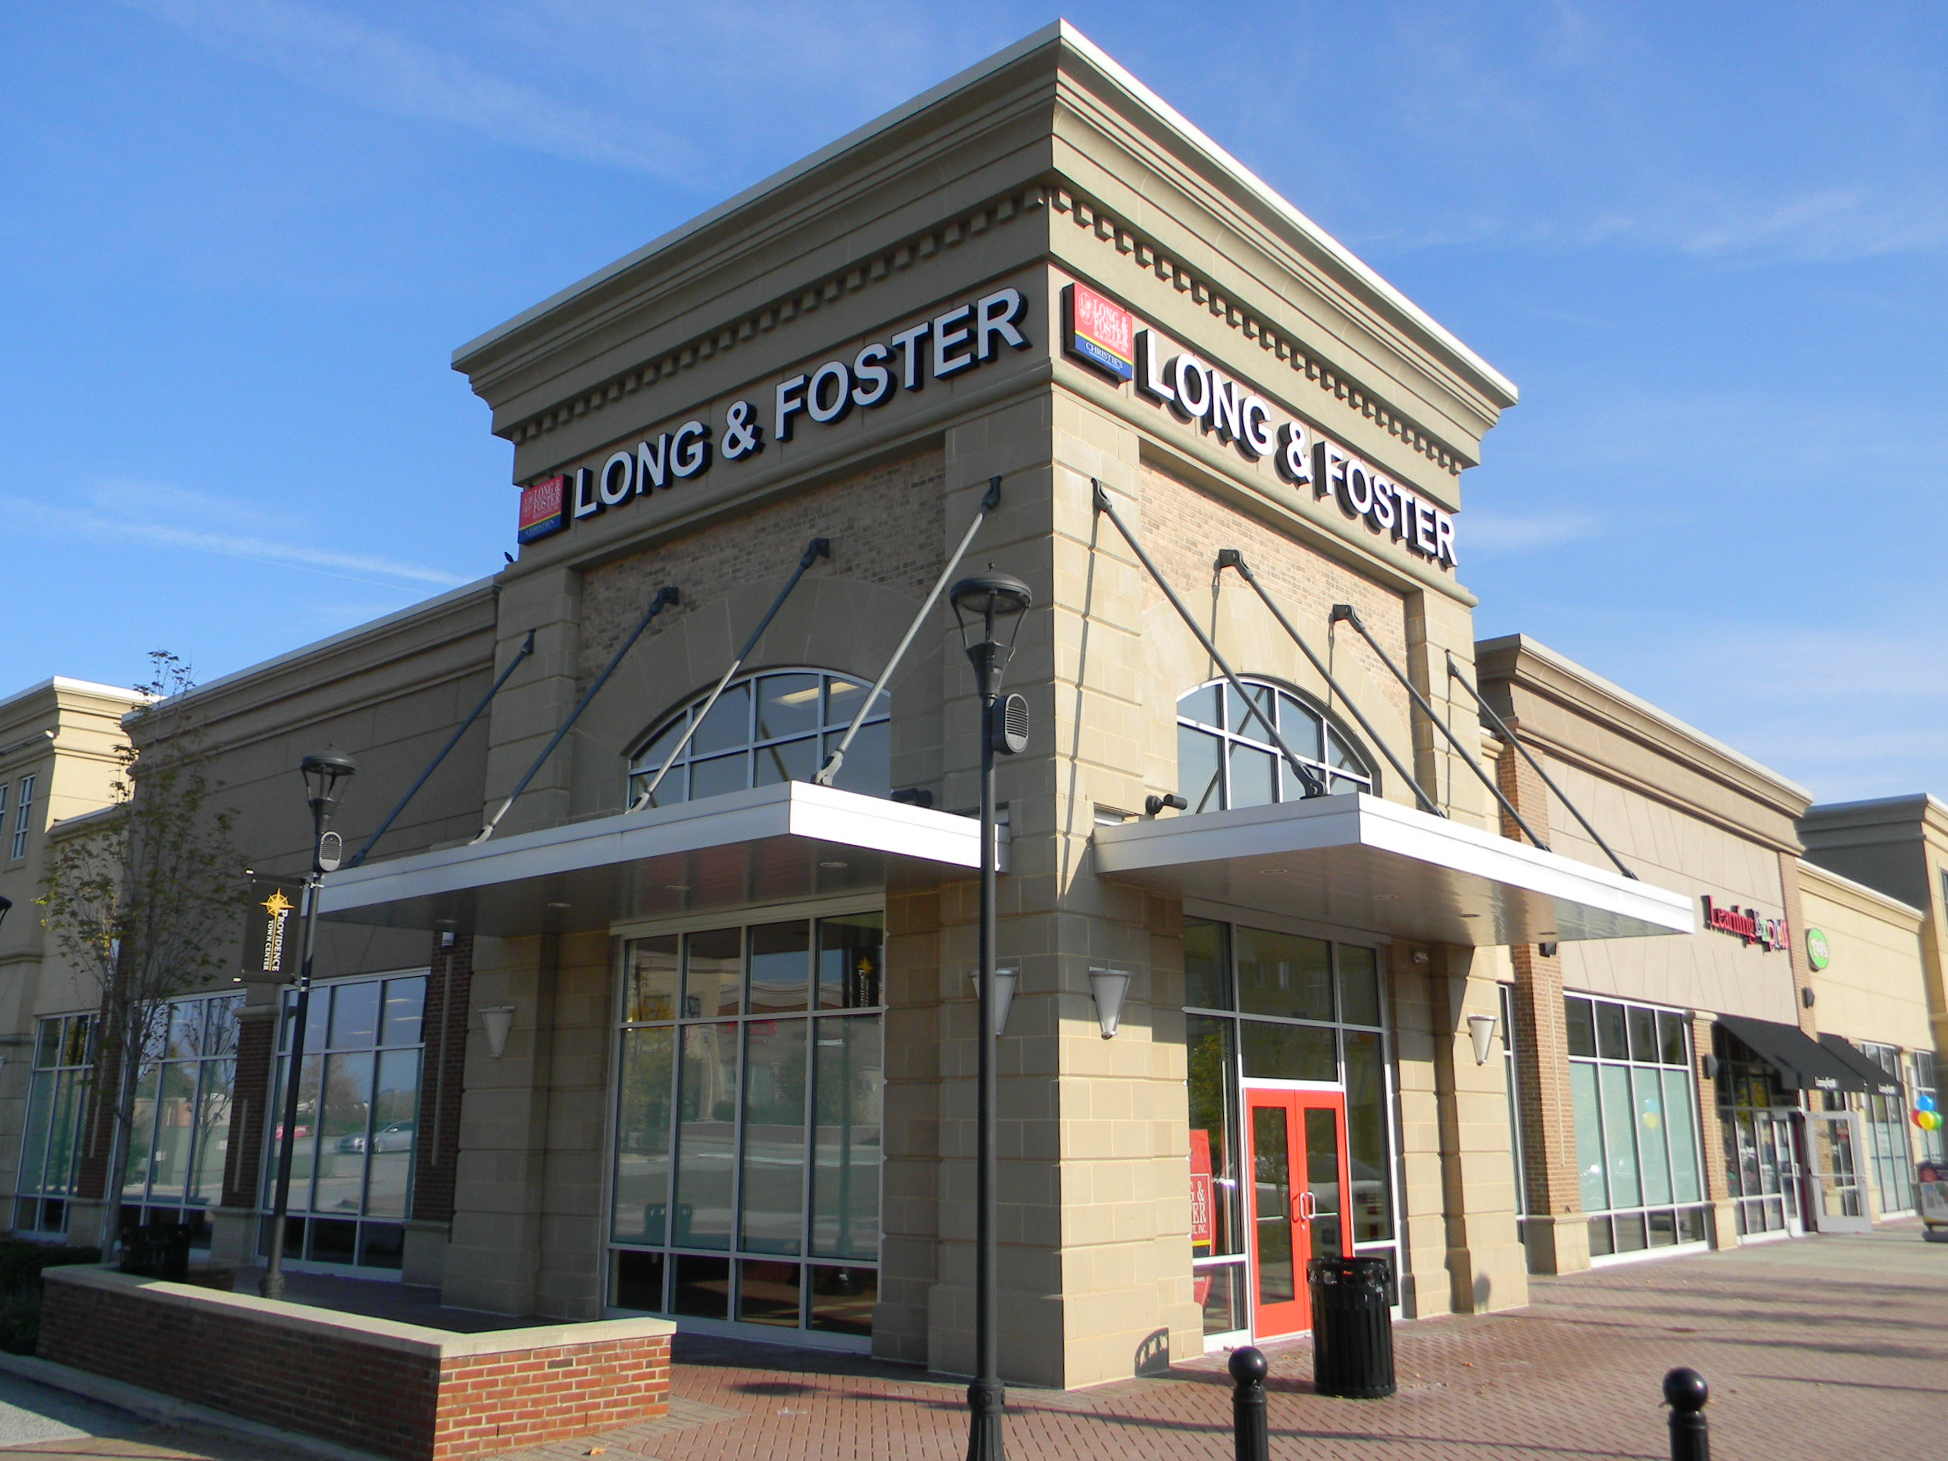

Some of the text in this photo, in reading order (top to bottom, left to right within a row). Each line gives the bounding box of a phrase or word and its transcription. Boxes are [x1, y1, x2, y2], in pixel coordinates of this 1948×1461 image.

[1093, 312, 1129, 348] FOSTER
[1094, 299, 1119, 327] LONG
[573, 287, 1027, 520] LONG & FOSTER
[1143, 329, 1459, 567] LONG & FOSTER
[533, 482, 554, 502] LONG
[533, 491, 560, 514] FOSTER
[271, 909, 289, 972] PROVIDENCE
[1707, 895, 1756, 945] Learning
[262, 919, 274, 971] TOWN CENTER
[1197, 1180, 1206, 1204] &
